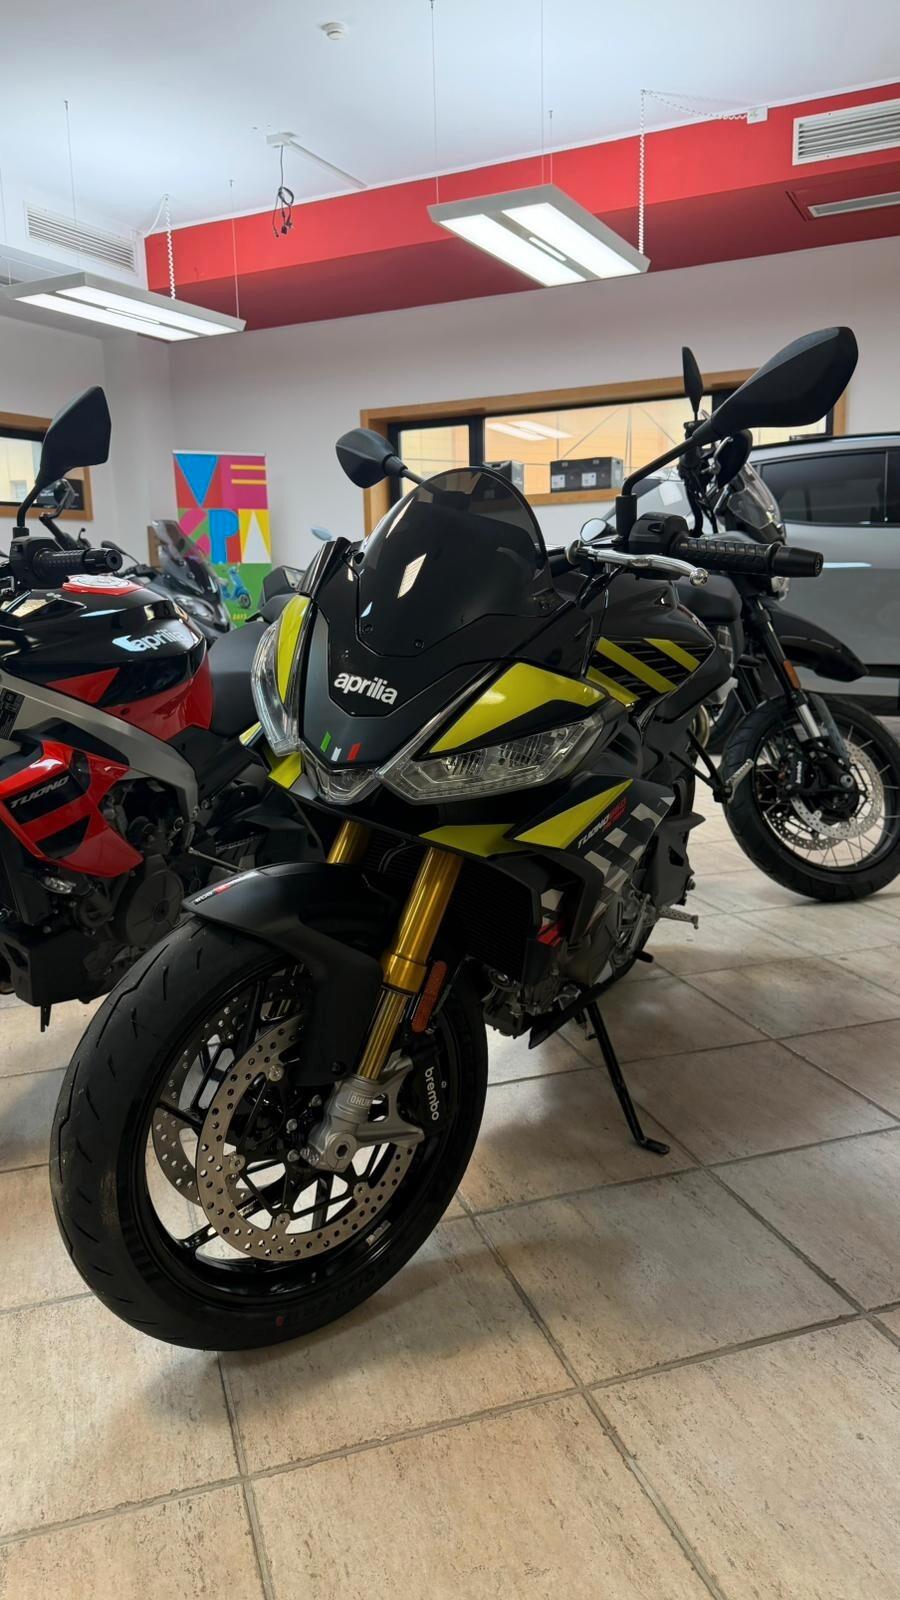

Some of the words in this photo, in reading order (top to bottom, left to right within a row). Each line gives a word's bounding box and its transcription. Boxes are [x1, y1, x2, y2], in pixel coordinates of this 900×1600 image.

[333, 672, 398, 705] aprilia
[9, 775, 70, 809] TUONO
[424, 1066, 440, 1121] brembo
